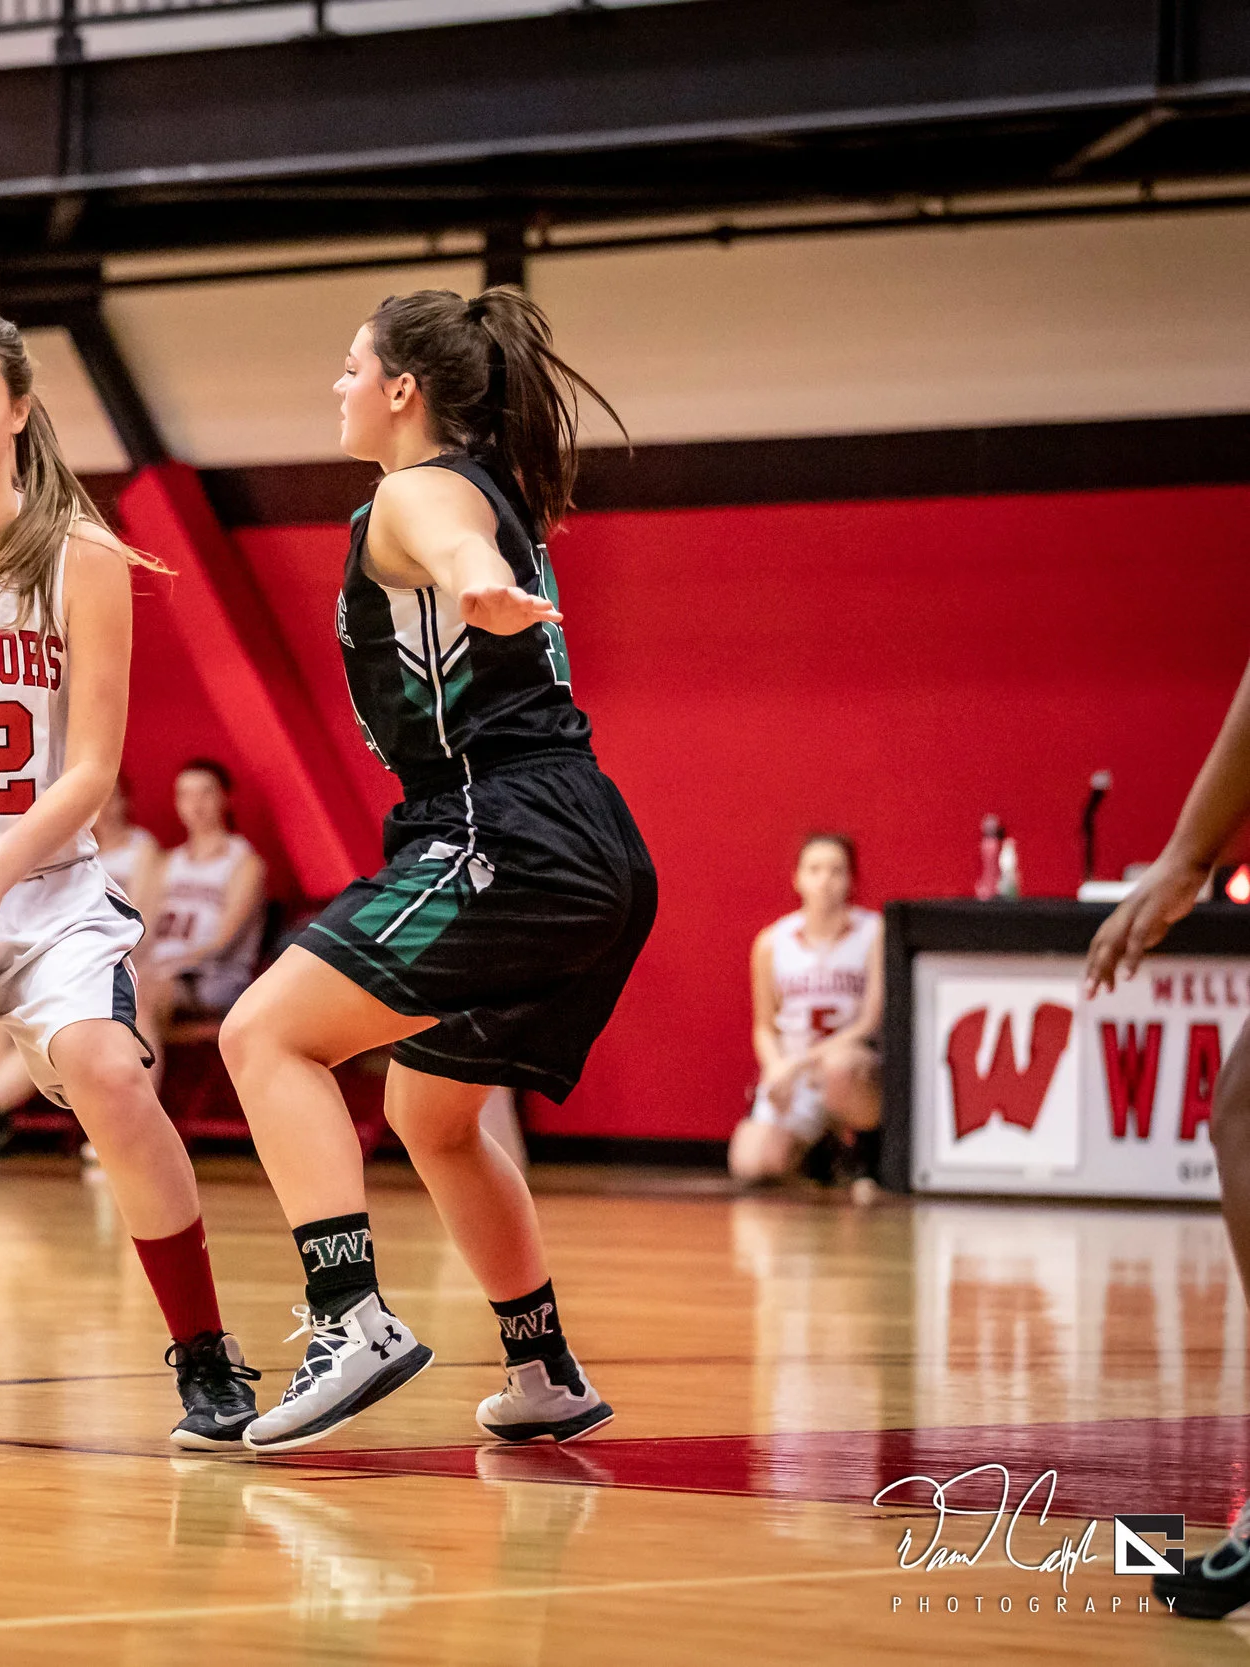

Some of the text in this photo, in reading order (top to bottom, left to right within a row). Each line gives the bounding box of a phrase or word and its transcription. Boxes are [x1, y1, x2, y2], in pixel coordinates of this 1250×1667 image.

[1152, 972, 1250, 1007] WELL
[946, 1001, 1074, 1142] W
[302, 1228, 372, 1273] W
